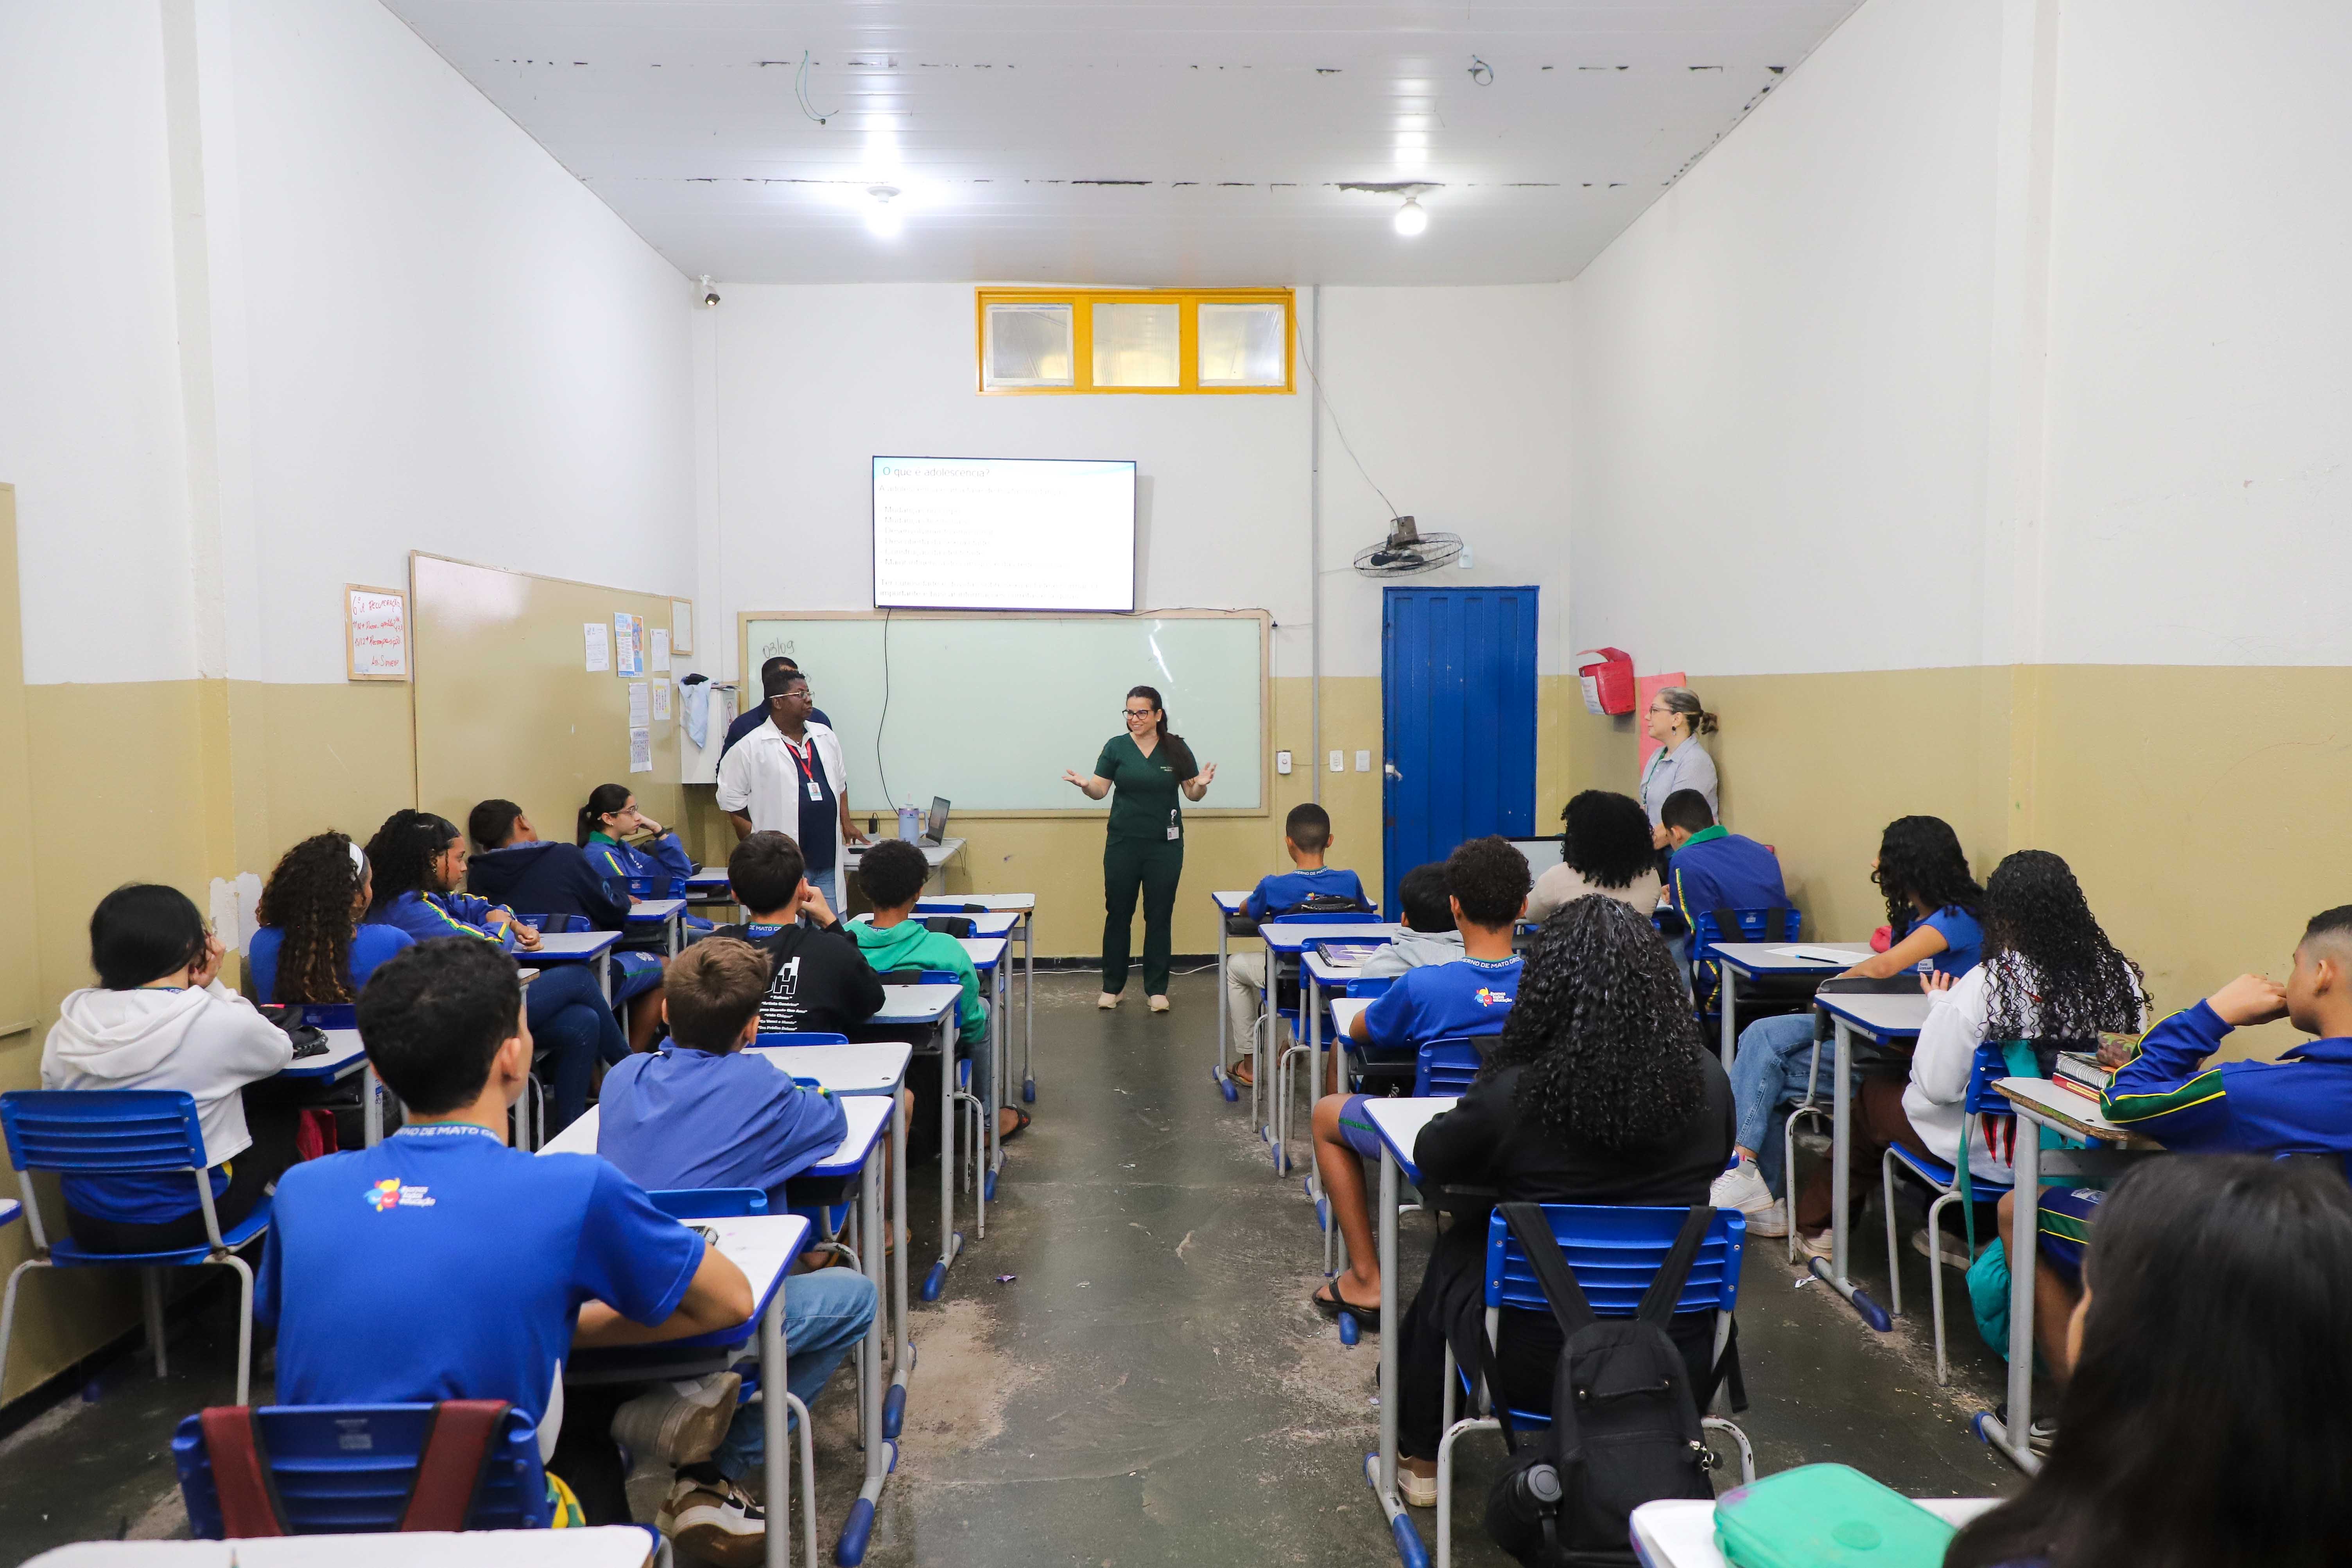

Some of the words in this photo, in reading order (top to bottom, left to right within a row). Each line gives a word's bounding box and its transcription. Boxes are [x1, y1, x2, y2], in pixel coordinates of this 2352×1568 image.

[882, 466, 891, 475] O
[894, 468, 912, 478] que
[915, 466, 921, 476] é
[924, 466, 990, 478] adolescência?
[762, 637, 794, 659] 03/09
[1490, 960, 1509, 969] MATO
[436, 1125, 479, 1136] MATO
